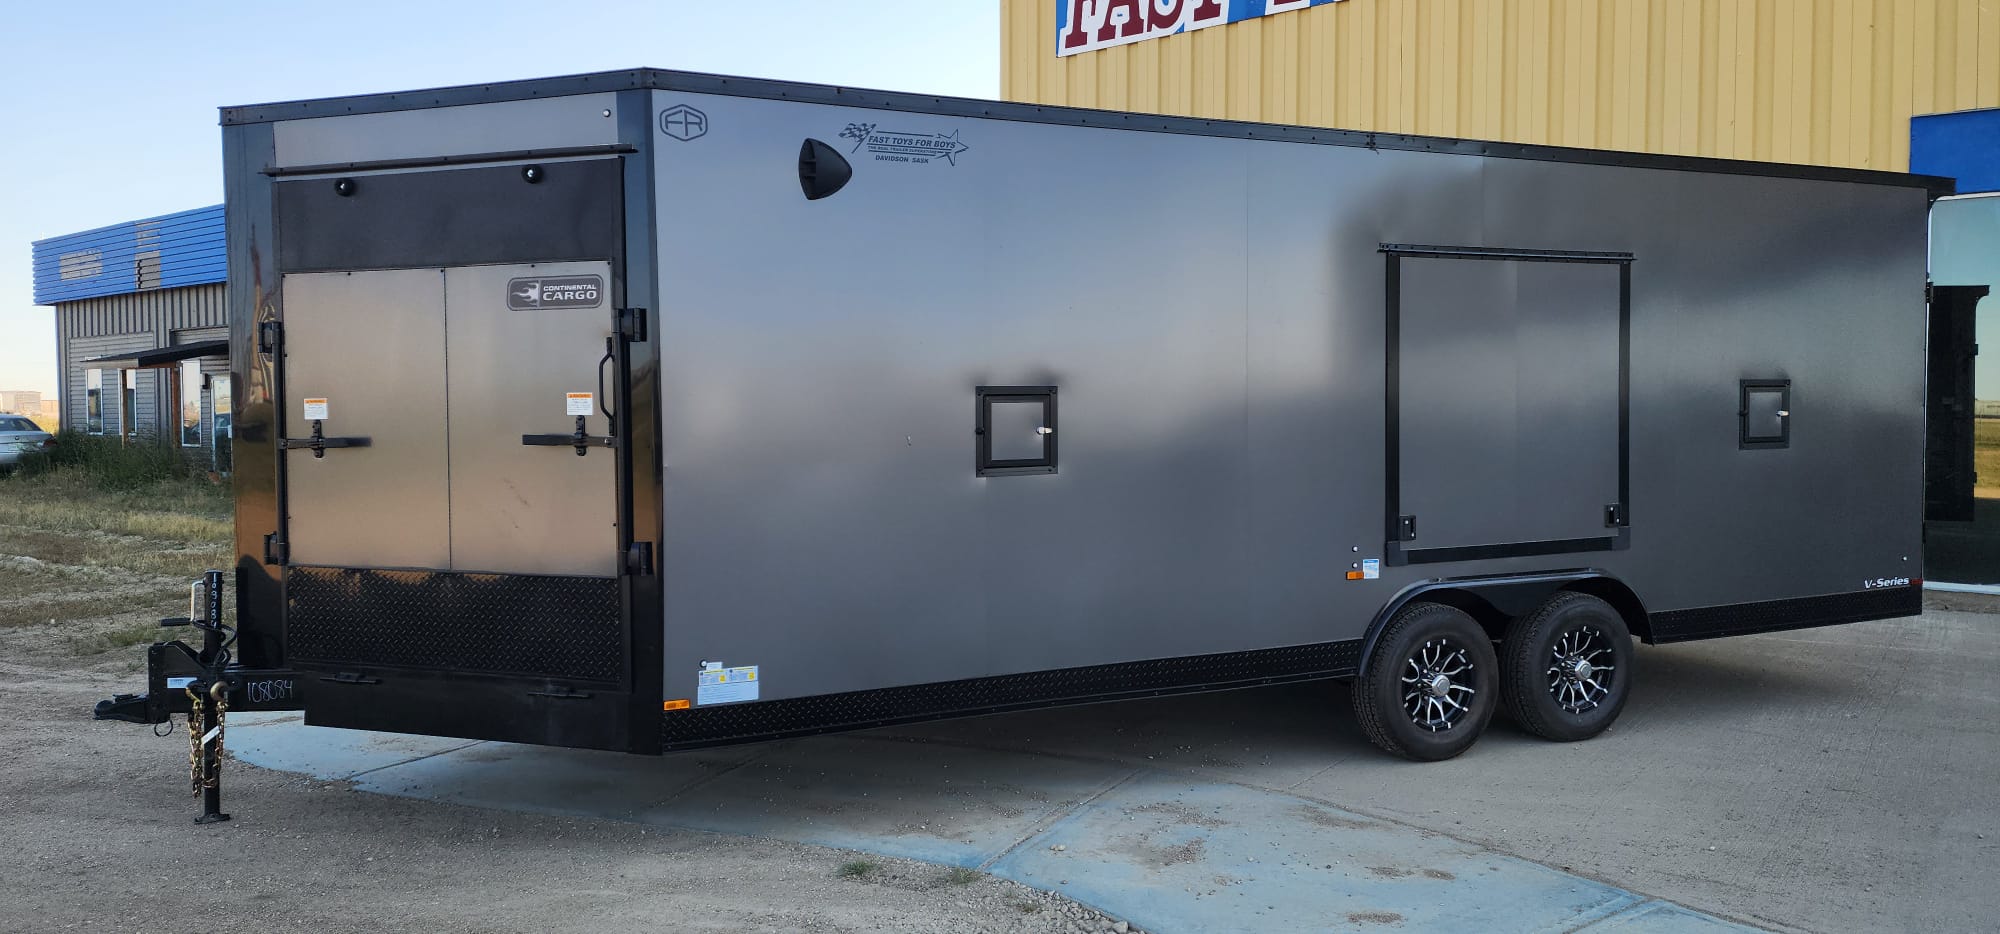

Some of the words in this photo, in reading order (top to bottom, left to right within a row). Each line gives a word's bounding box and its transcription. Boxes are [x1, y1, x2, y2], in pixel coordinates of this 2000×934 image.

[664, 109, 703, 137] FR
[868, 136, 891, 144] FAST
[892, 137, 914, 146] TOYS
[915, 139, 932, 147] FOR
[934, 141, 956, 149] BOYS
[542, 291, 597, 301] CARGO
[1864, 576, 1909, 589] V-Series
[247, 679, 293, 702] 108084
